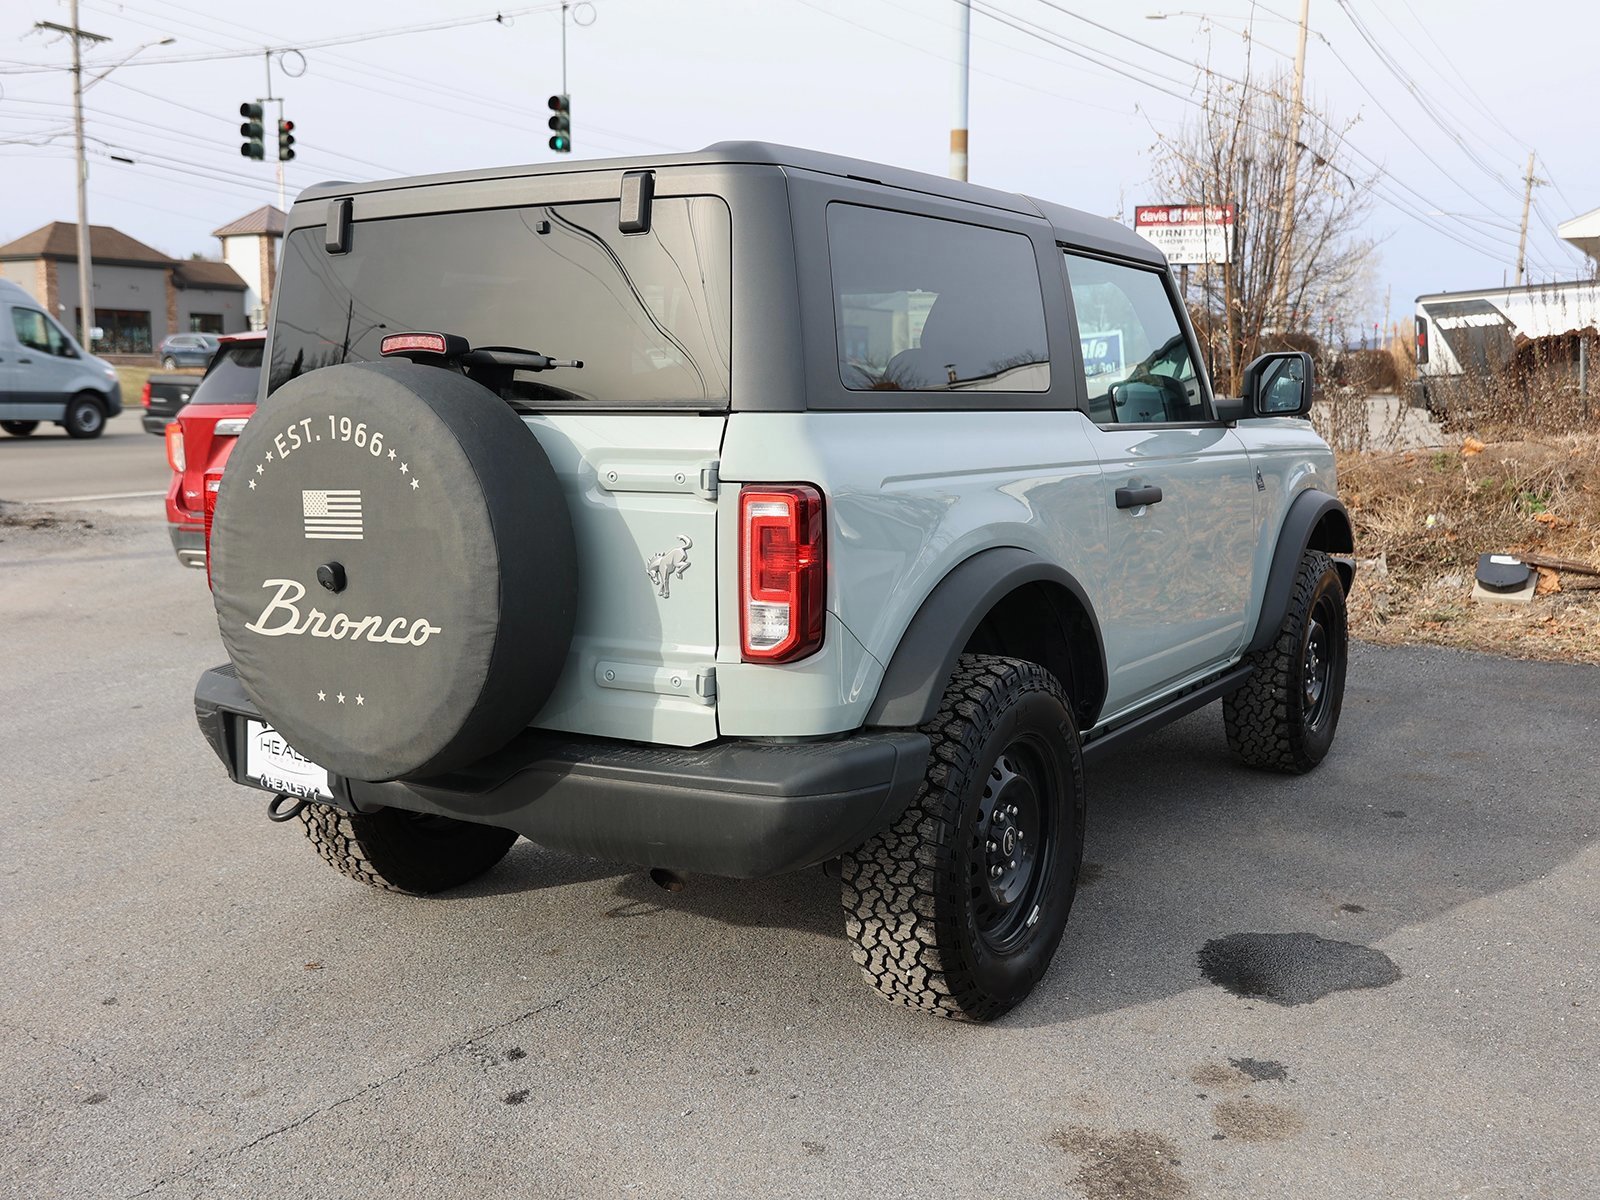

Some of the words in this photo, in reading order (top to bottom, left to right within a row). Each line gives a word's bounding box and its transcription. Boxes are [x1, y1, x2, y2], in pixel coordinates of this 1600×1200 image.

[1140, 210, 1168, 222] davis
[1149, 229, 1220, 237] FURNITURE
[274, 417, 321, 459] EST.
[328, 415, 384, 457] 1966
[244, 578, 442, 646] Bronco
[261, 737, 312, 763] HEAL
[266, 778, 311, 798] HEALEY
